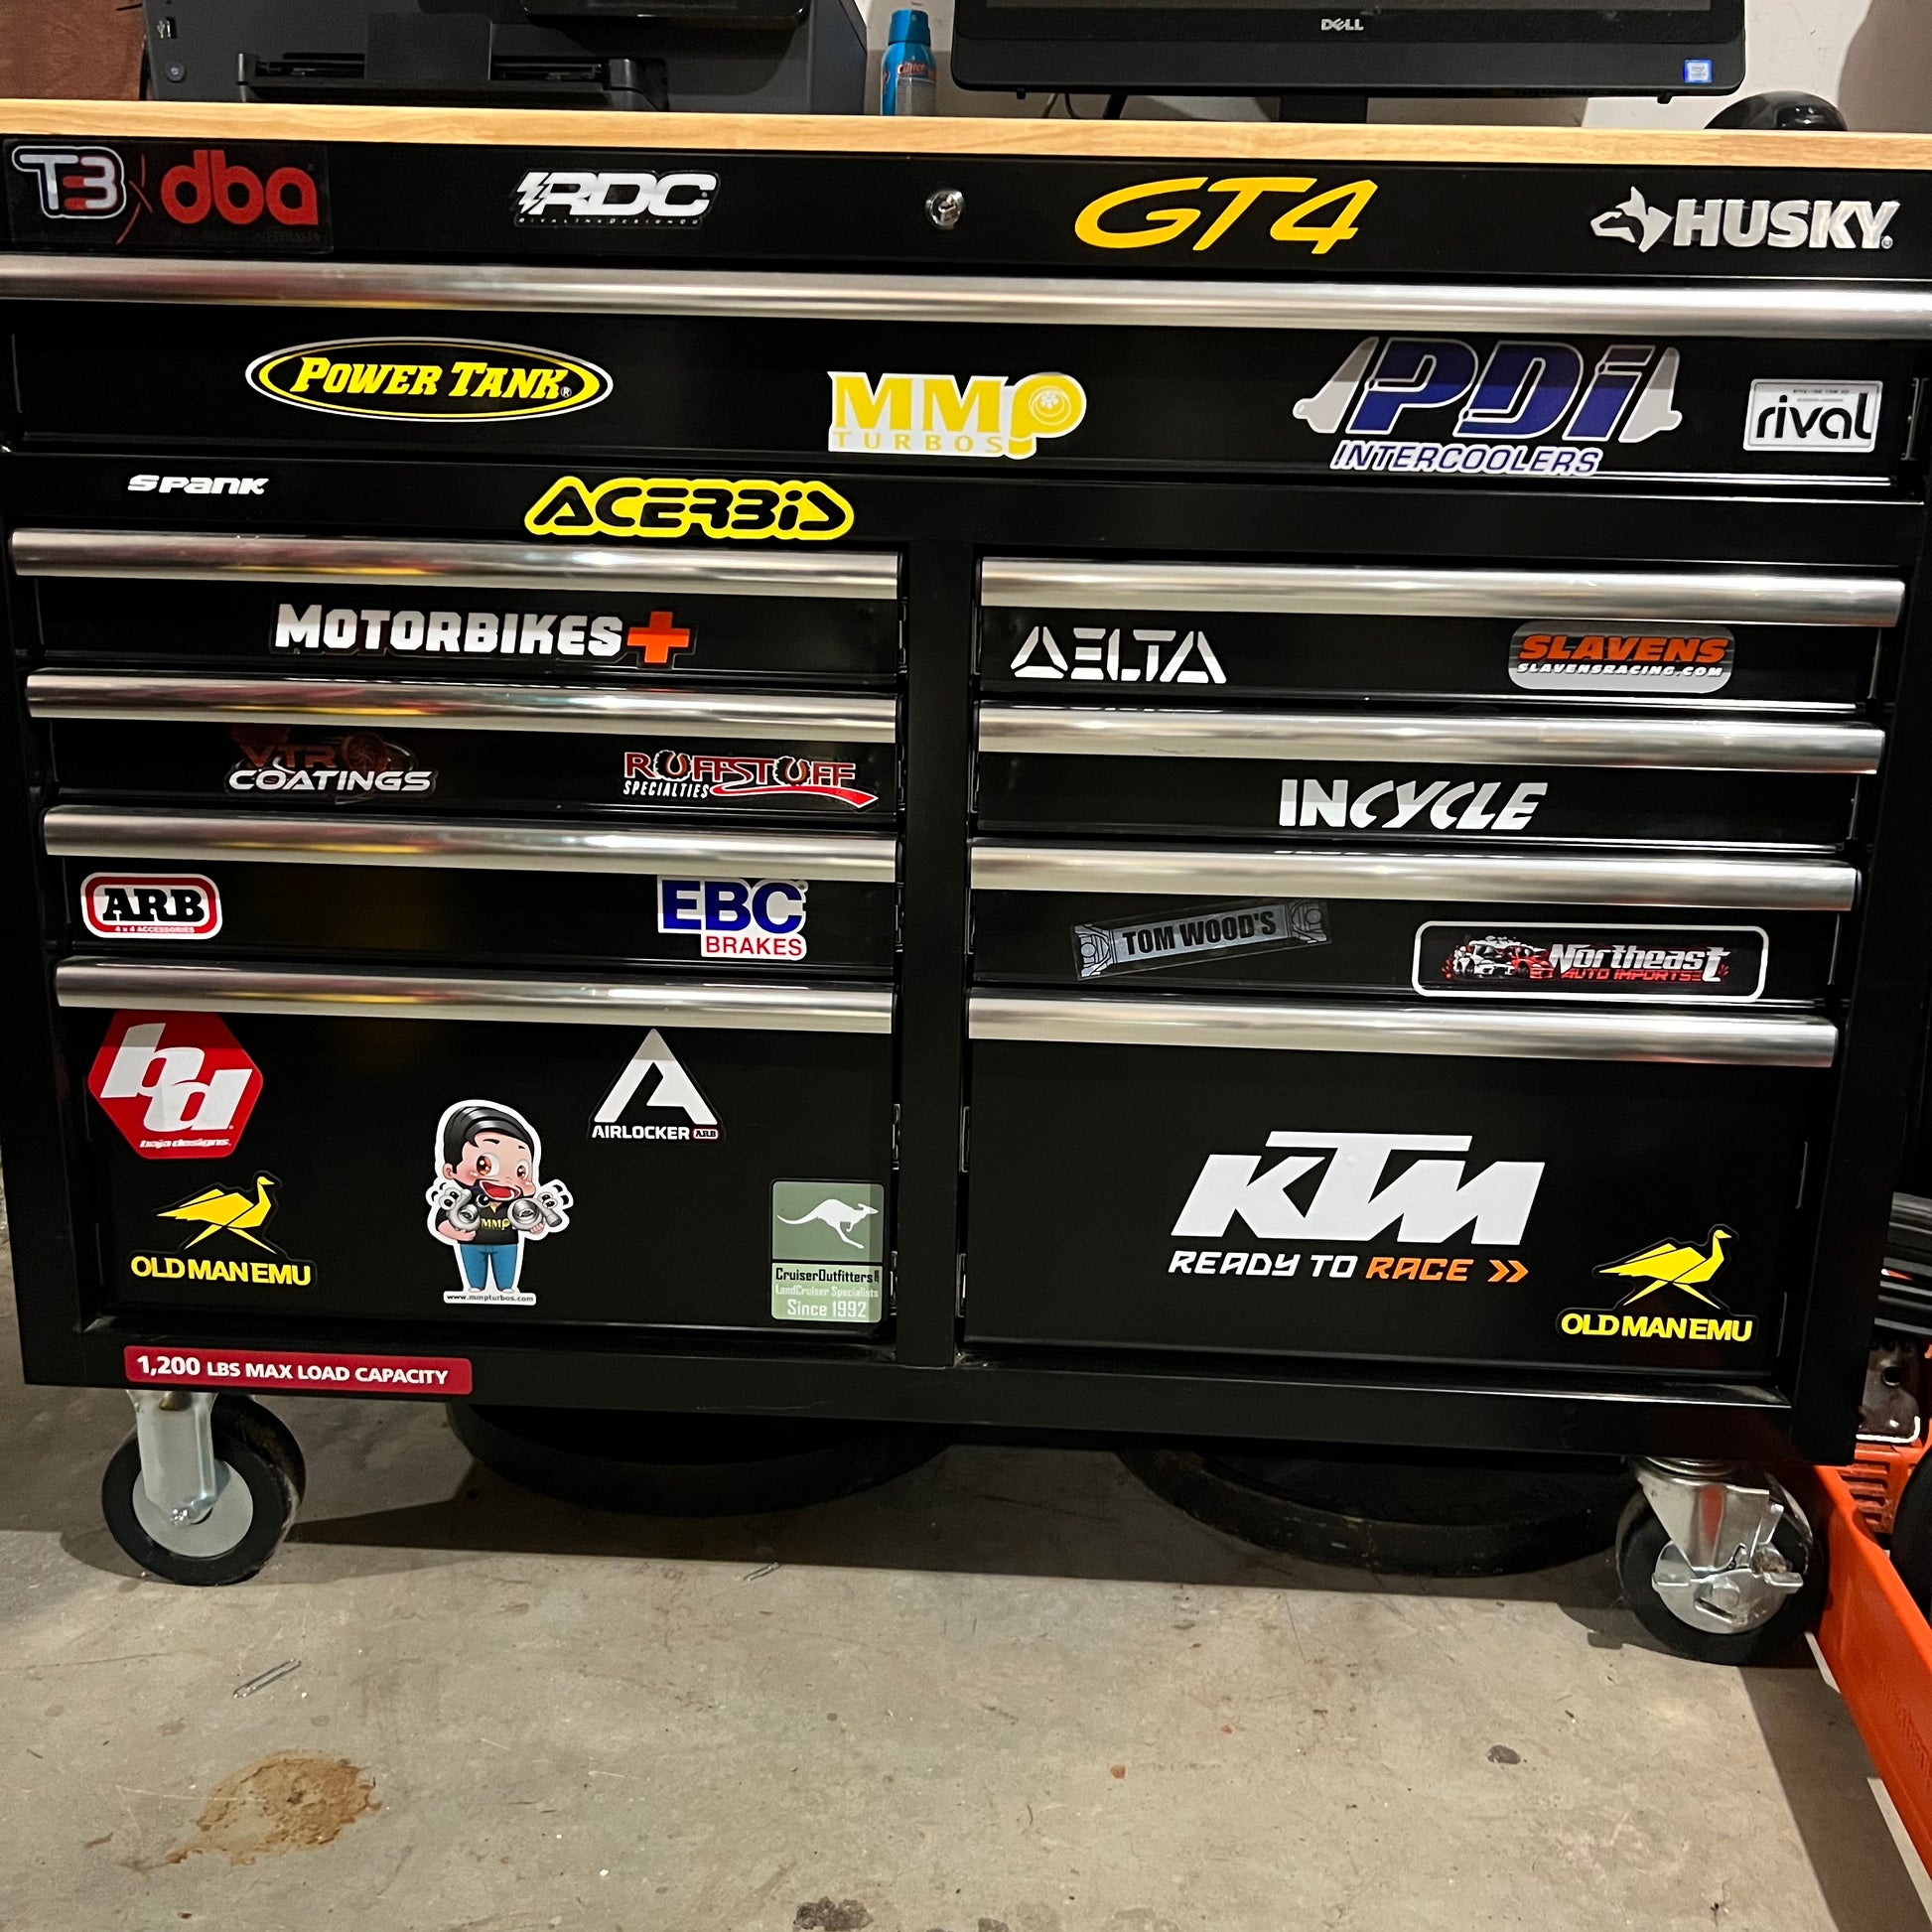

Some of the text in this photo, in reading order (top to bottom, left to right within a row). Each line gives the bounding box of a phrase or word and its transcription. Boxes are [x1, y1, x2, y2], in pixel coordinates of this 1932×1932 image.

[1321, 18, 1364, 31] DELL
[161, 150, 319, 224] dba
[517, 172, 717, 216] RDC
[1075, 177, 1378, 254] GT4
[1673, 199, 1900, 248] HUSKY
[290, 356, 443, 395] POWER
[834, 373, 1086, 457] MMP
[1756, 393, 1871, 440] rival
[832, 431, 1003, 454] TURBOS
[1334, 442, 1600, 475] INTERCOOLERS
[1519, 634, 1729, 663] SLAVENS
[1517, 663, 1724, 677] SLAVENSRACING.COM
[229, 770, 433, 791] COATINGS
[623, 780, 710, 798] SPECIALTIES
[1279, 779, 1548, 830] INCYCLE
[103, 888, 205, 922] ARB
[662, 880, 803, 934] EBC
[706, 936, 802, 956] BRAKES
[1122, 911, 1277, 955] TOM WOOD'S
[1549, 943, 1730, 982] Northeast
[1561, 968, 1609, 980] AUTO
[592, 1125, 690, 1140] AIRLOCKER
[1171, 1131, 1546, 1246] KTM
[131, 1256, 311, 1286] OLD MAN EMU
[1169, 1250, 1474, 1282] READY TO RACE
[787, 1299, 867, 1317] Since 1992
[1561, 1312, 1752, 1341] OLD MAN EMU
[137, 1355, 449, 1385] 1,200 LBS MAX LOAD CAPACITY
